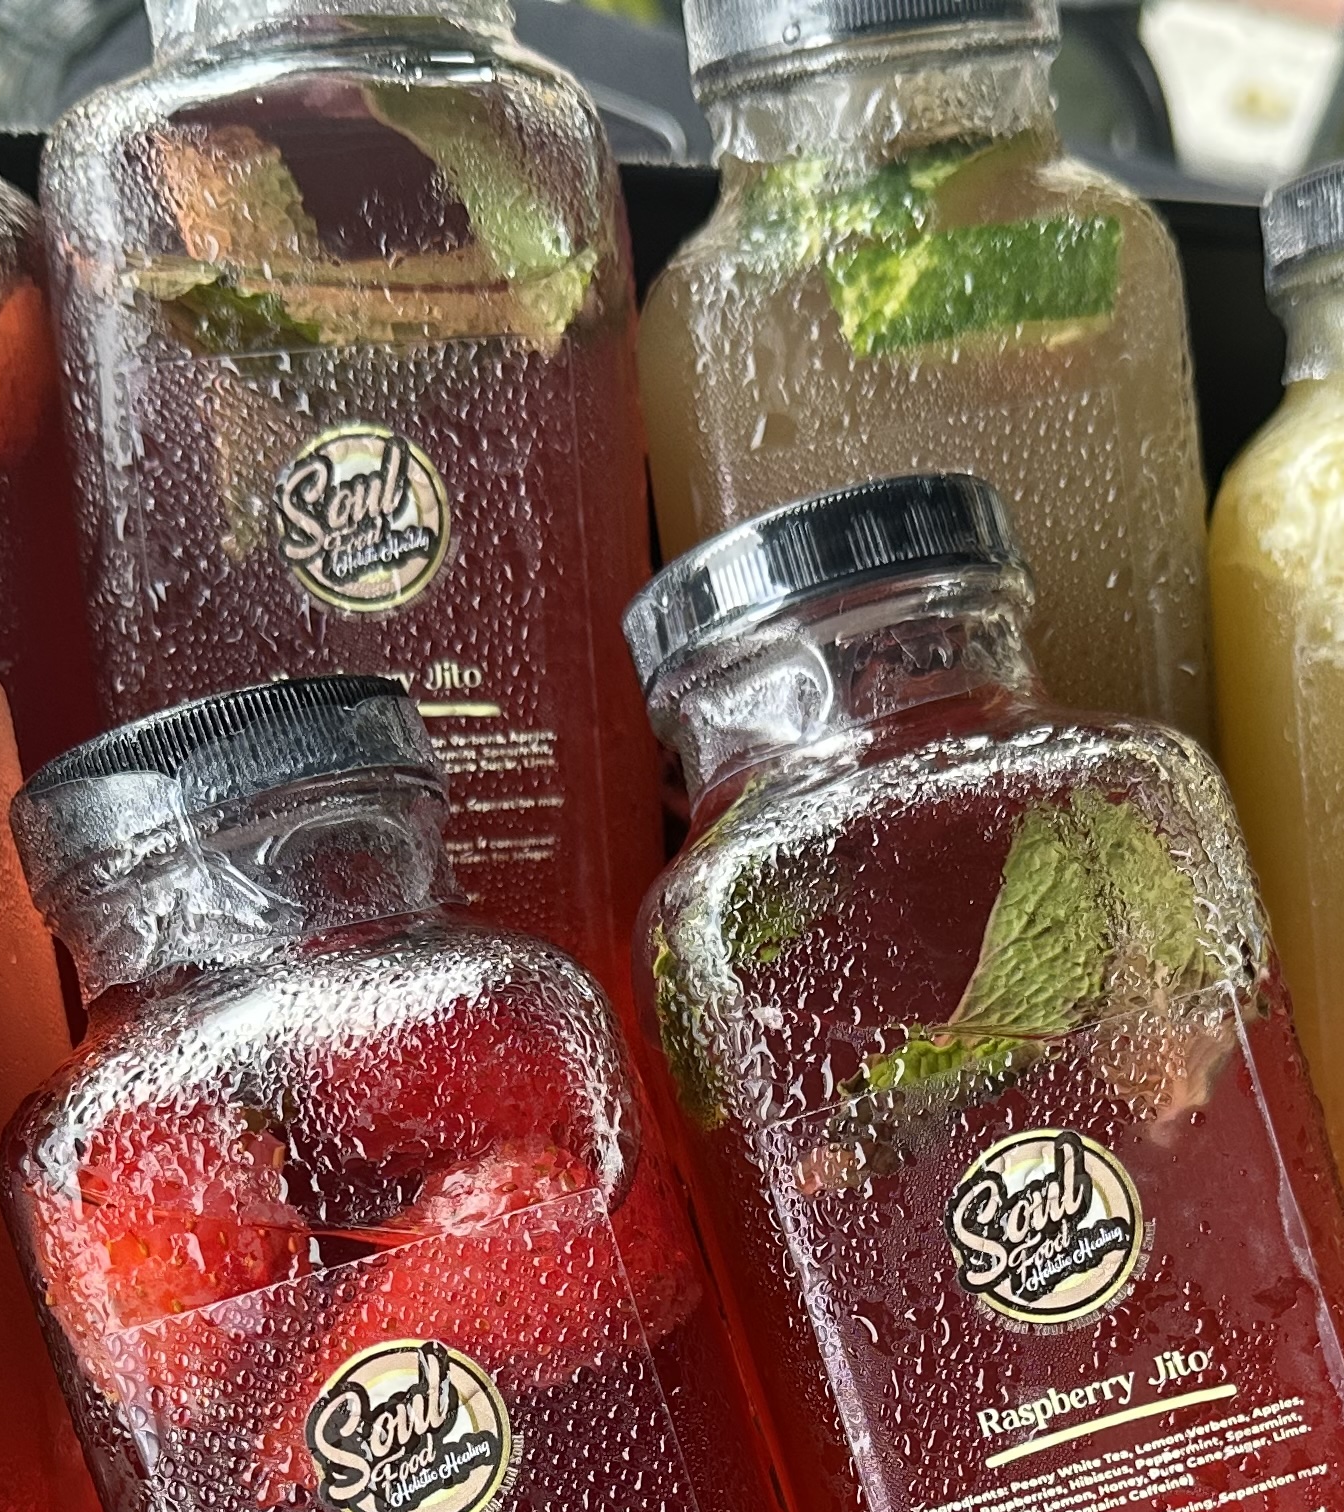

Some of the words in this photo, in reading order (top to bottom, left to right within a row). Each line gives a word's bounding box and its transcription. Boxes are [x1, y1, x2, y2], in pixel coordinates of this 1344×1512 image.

[281, 443, 406, 562] Soul
[425, 661, 482, 690] Jito
[951, 1142, 1085, 1287] Soul
[1008, 1219, 1071, 1290] Food
[1026, 1256, 1072, 1291] Holistic
[1073, 1225, 1125, 1264] Healing
[312, 1351, 452, 1502] Soul
[978, 1373, 1133, 1442] Raspberry
[1148, 1347, 1212, 1385] Jito
[371, 1432, 437, 1502] Food
[390, 1469, 438, 1508] Holistic
[439, 1439, 491, 1480] Healing
[1010, 1473, 1055, 1493] Peony
[1057, 1458, 1101, 1478] White
[1103, 1450, 1134, 1464] Tea,
[1135, 1433, 1183, 1455] Lemon
[1252, 1396, 1305, 1419] Apples,
[1043, 1491, 1097, 1512] Lemon,
[1148, 1463, 1184, 1480] Pure
[1186, 1451, 1223, 1468] Cane
[1272, 1424, 1312, 1442] Lime.
[1069, 1465, 1134, 1490] Hibiscus,
[1135, 1437, 1223, 1470] Peppermint,
[1225, 1412, 1303, 1442] Spearmint,
[1129, 1473, 1194, 1501] Caffeine)
